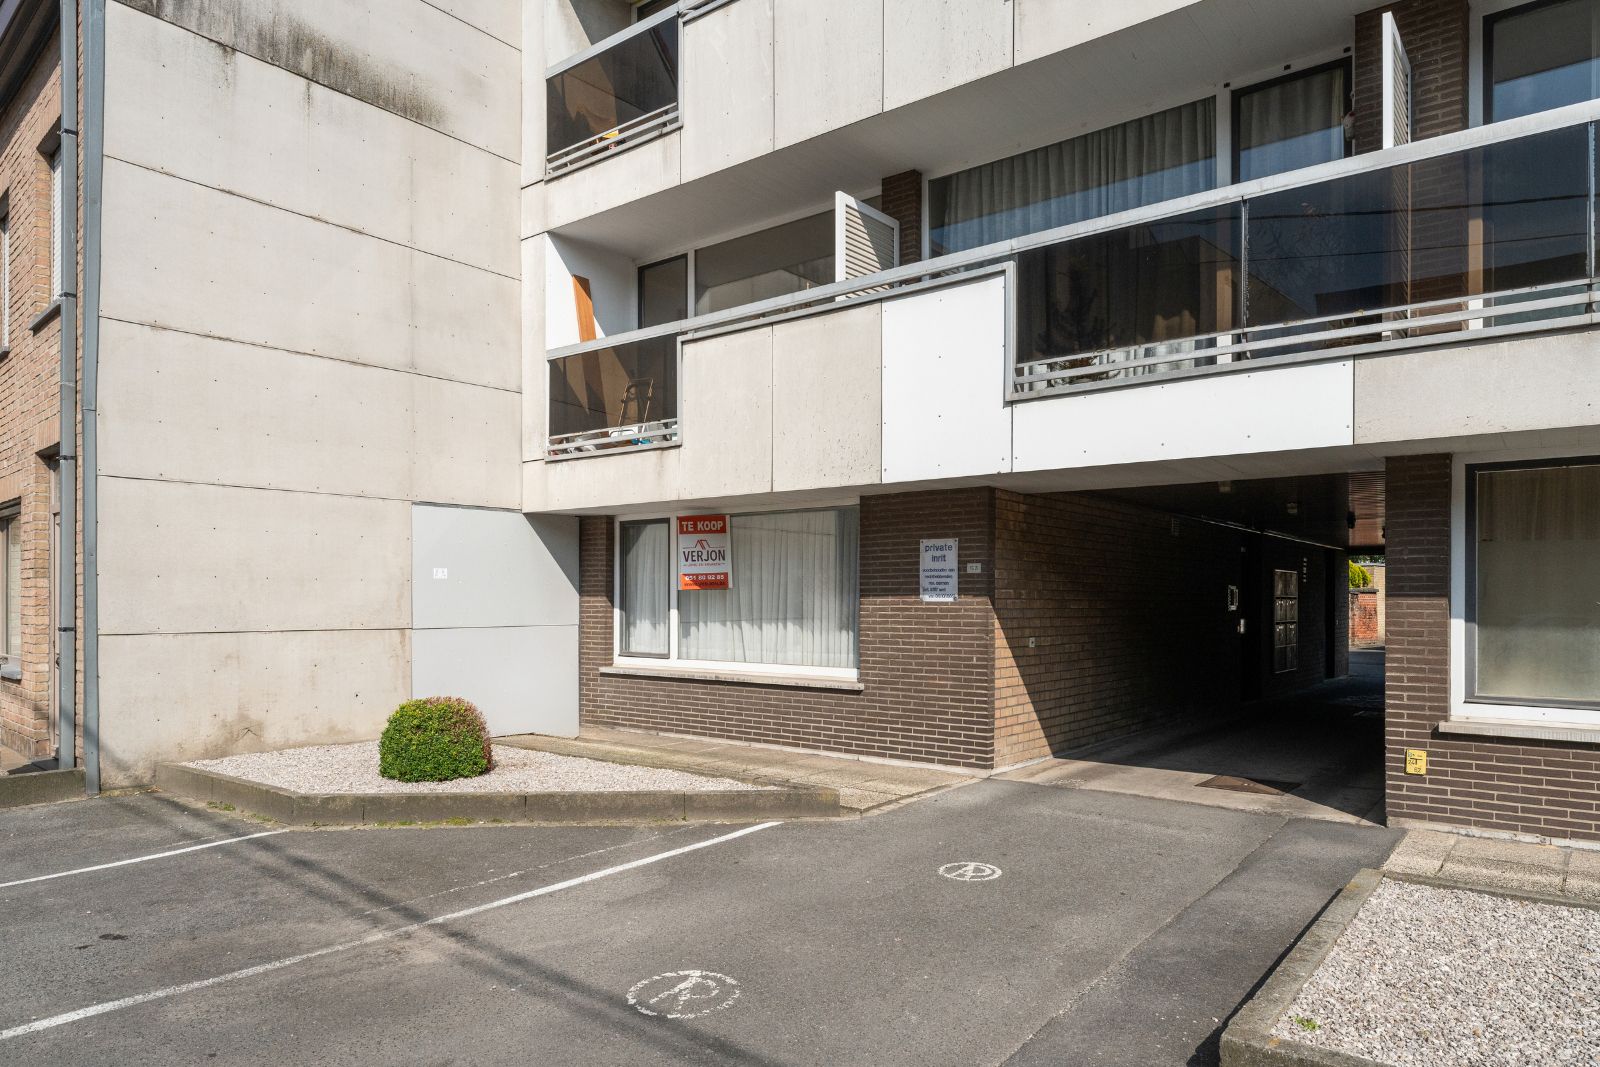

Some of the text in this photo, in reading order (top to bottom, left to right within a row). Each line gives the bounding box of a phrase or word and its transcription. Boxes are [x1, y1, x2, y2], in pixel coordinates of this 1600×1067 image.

[681, 520, 724, 532] TE KOOP
[924, 543, 953, 553] private
[682, 549, 726, 562] VERJON
[931, 554, 946, 562] inrit
